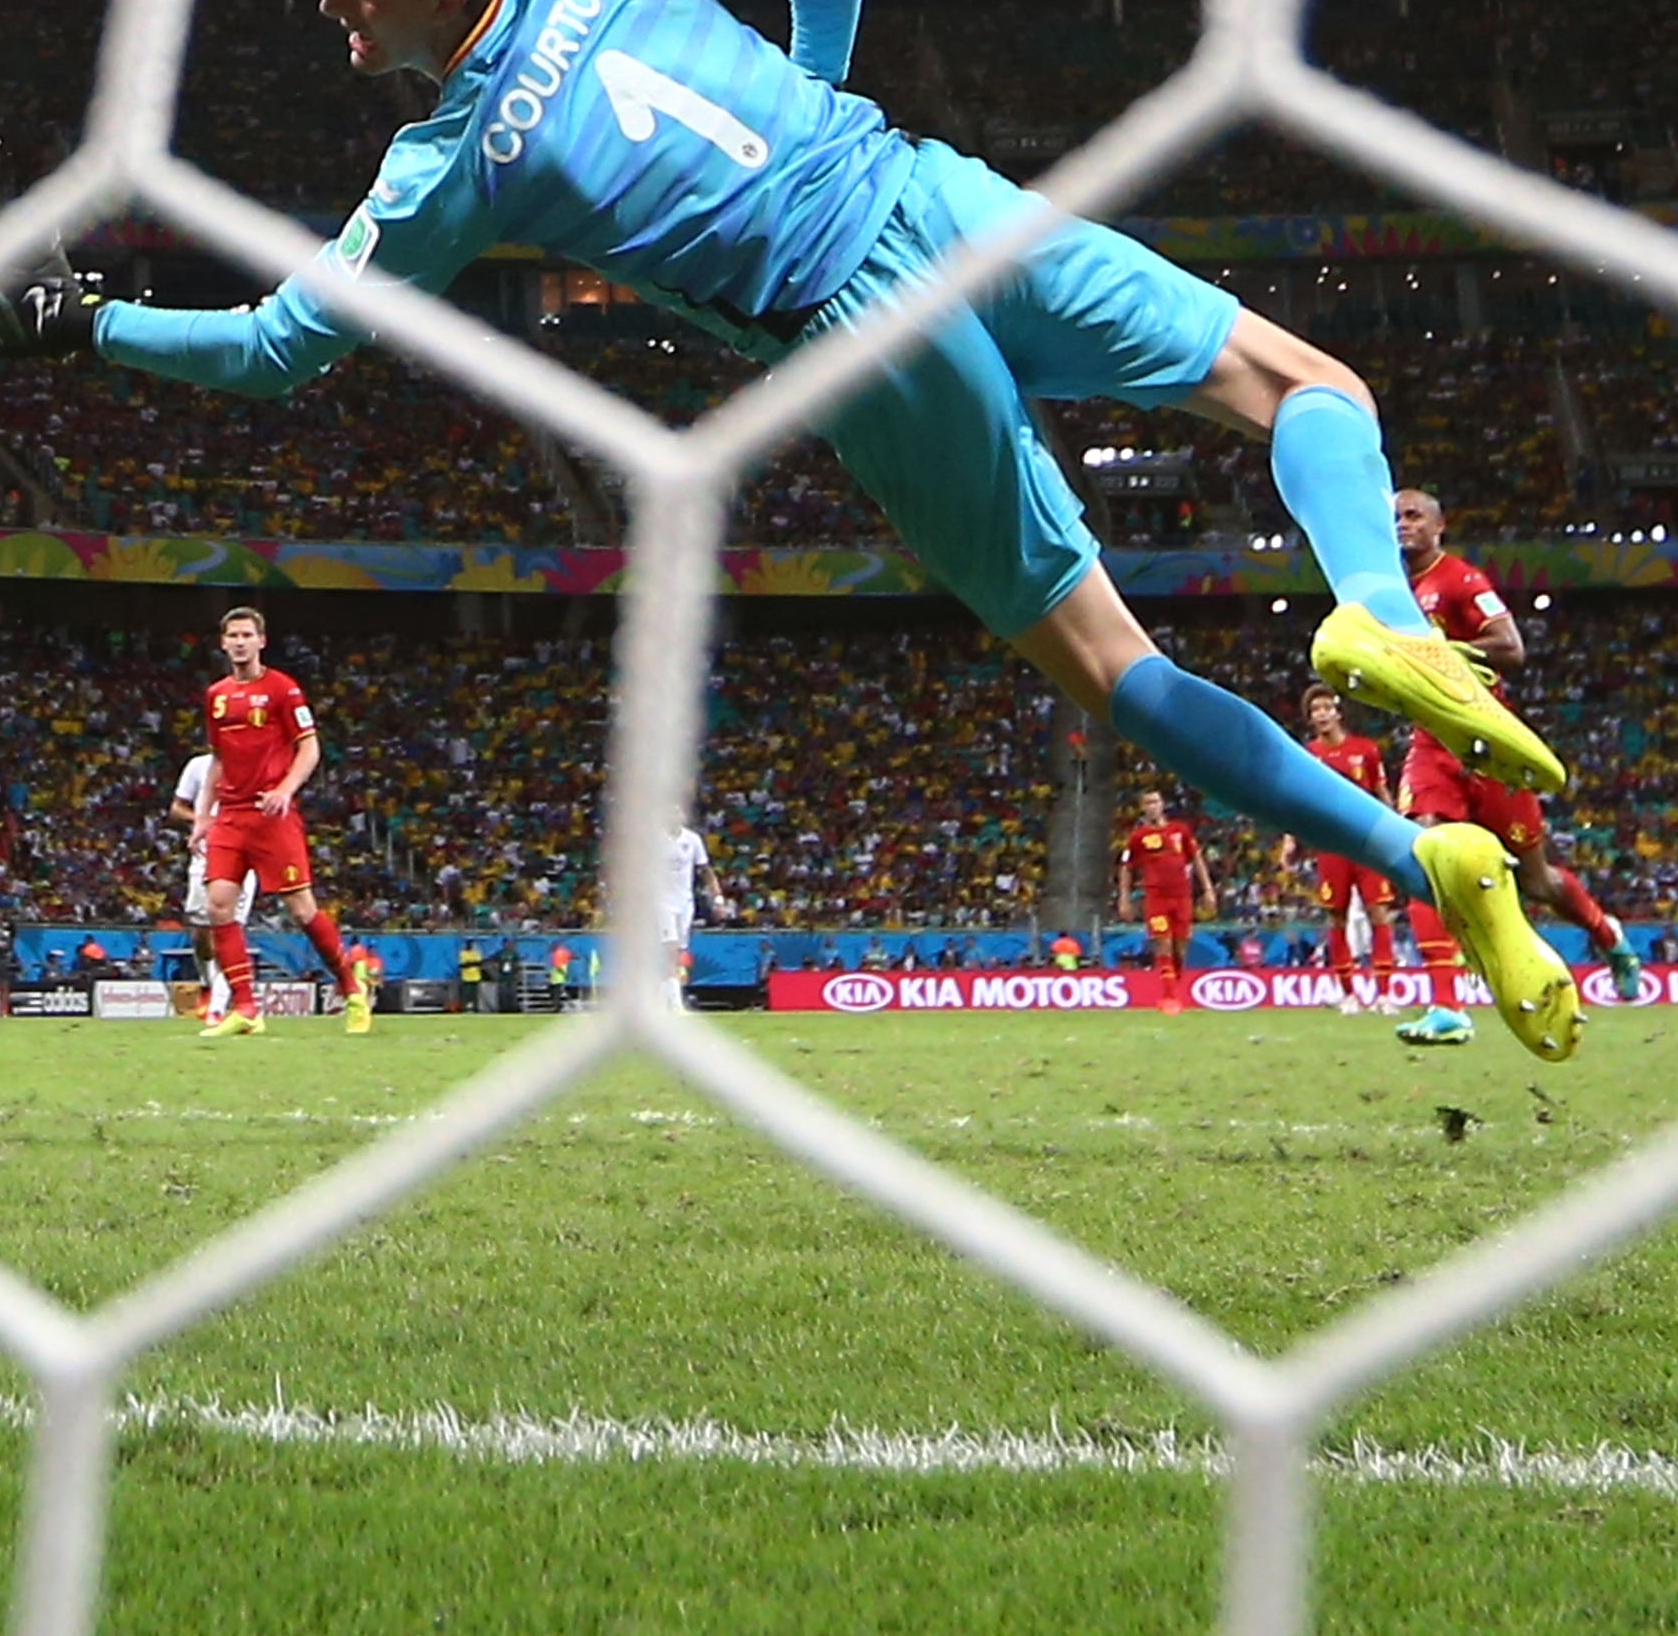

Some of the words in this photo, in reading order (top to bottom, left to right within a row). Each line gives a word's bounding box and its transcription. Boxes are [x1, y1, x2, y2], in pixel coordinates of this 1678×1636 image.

[594, 48, 769, 168] 1
[212, 695, 228, 719] 5
[899, 977, 964, 1007] KIA
[972, 976, 1129, 1008] MOTORS
[1273, 974, 1341, 1006] KIA
